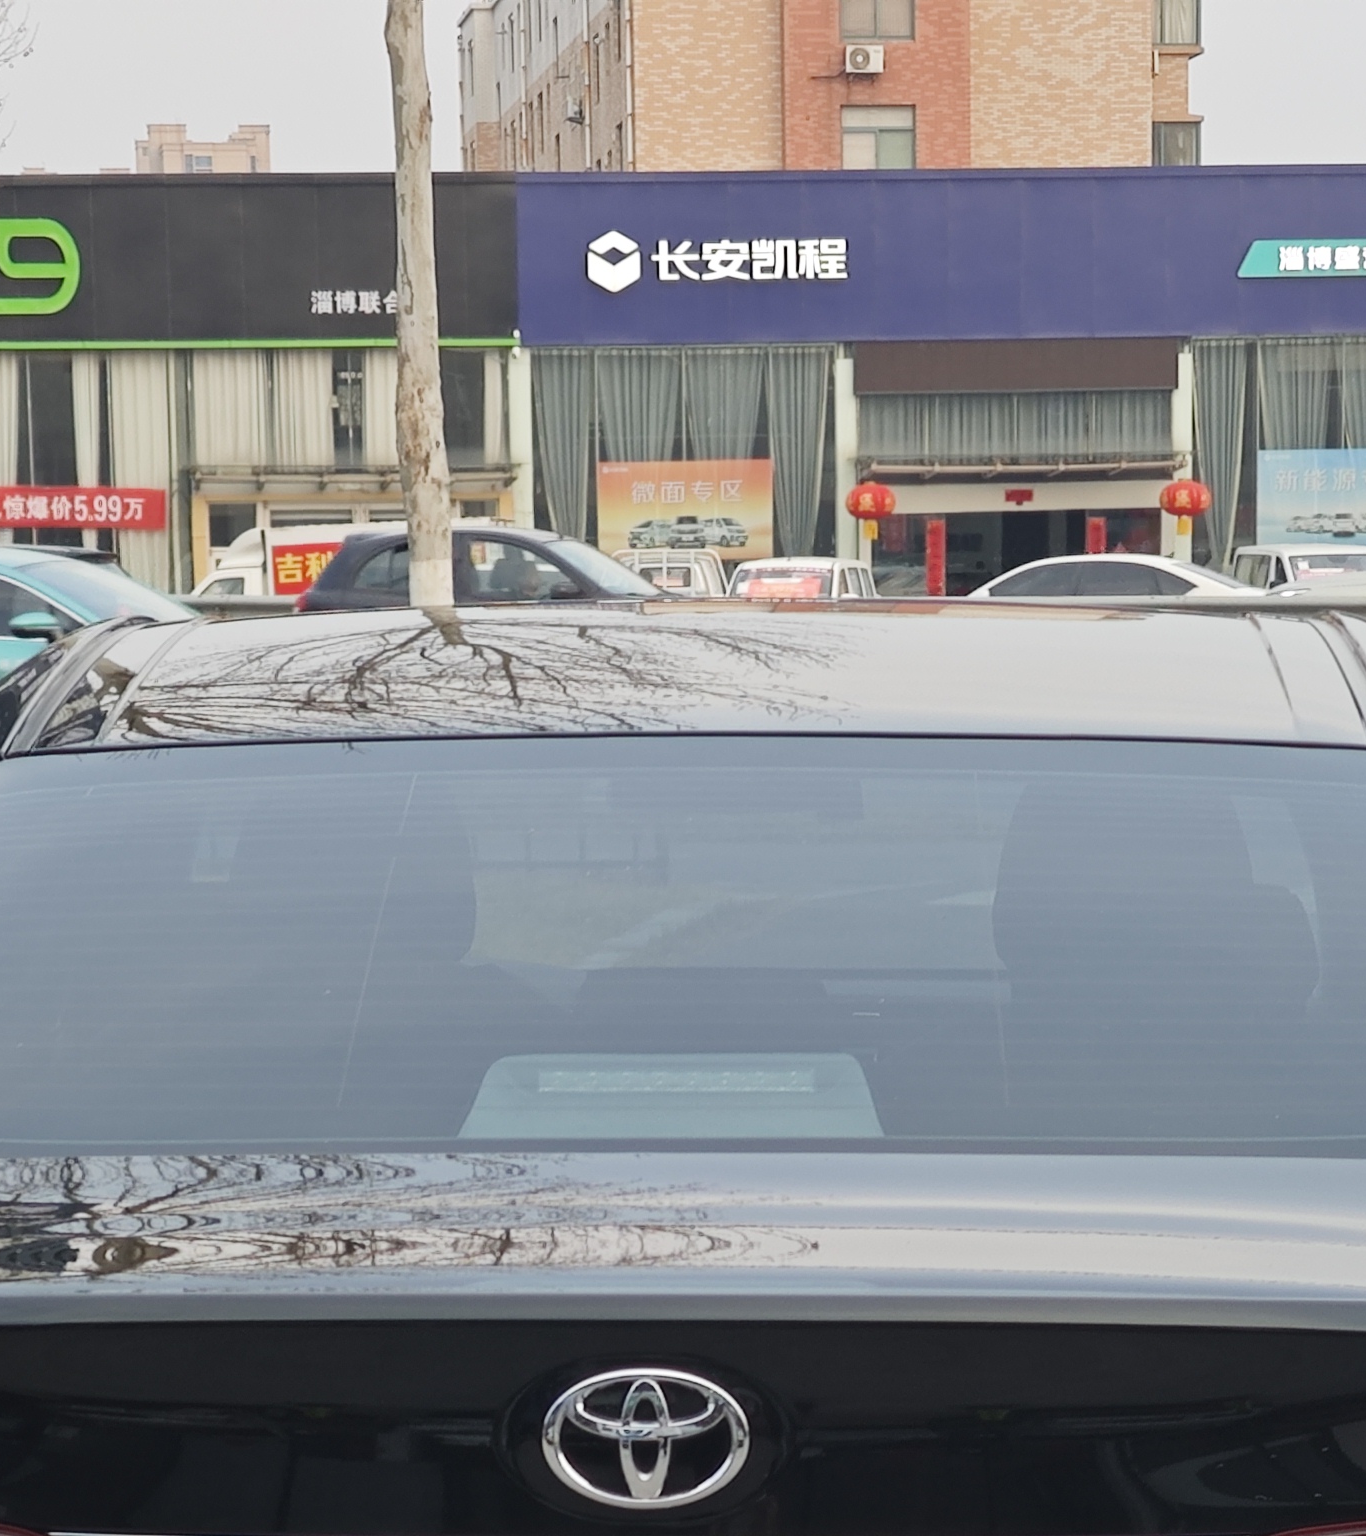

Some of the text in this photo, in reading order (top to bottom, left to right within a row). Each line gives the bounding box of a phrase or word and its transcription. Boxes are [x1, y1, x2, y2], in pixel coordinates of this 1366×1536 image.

[650, 239, 849, 281] 长安凯程
[631, 479, 744, 504] 微面专区
